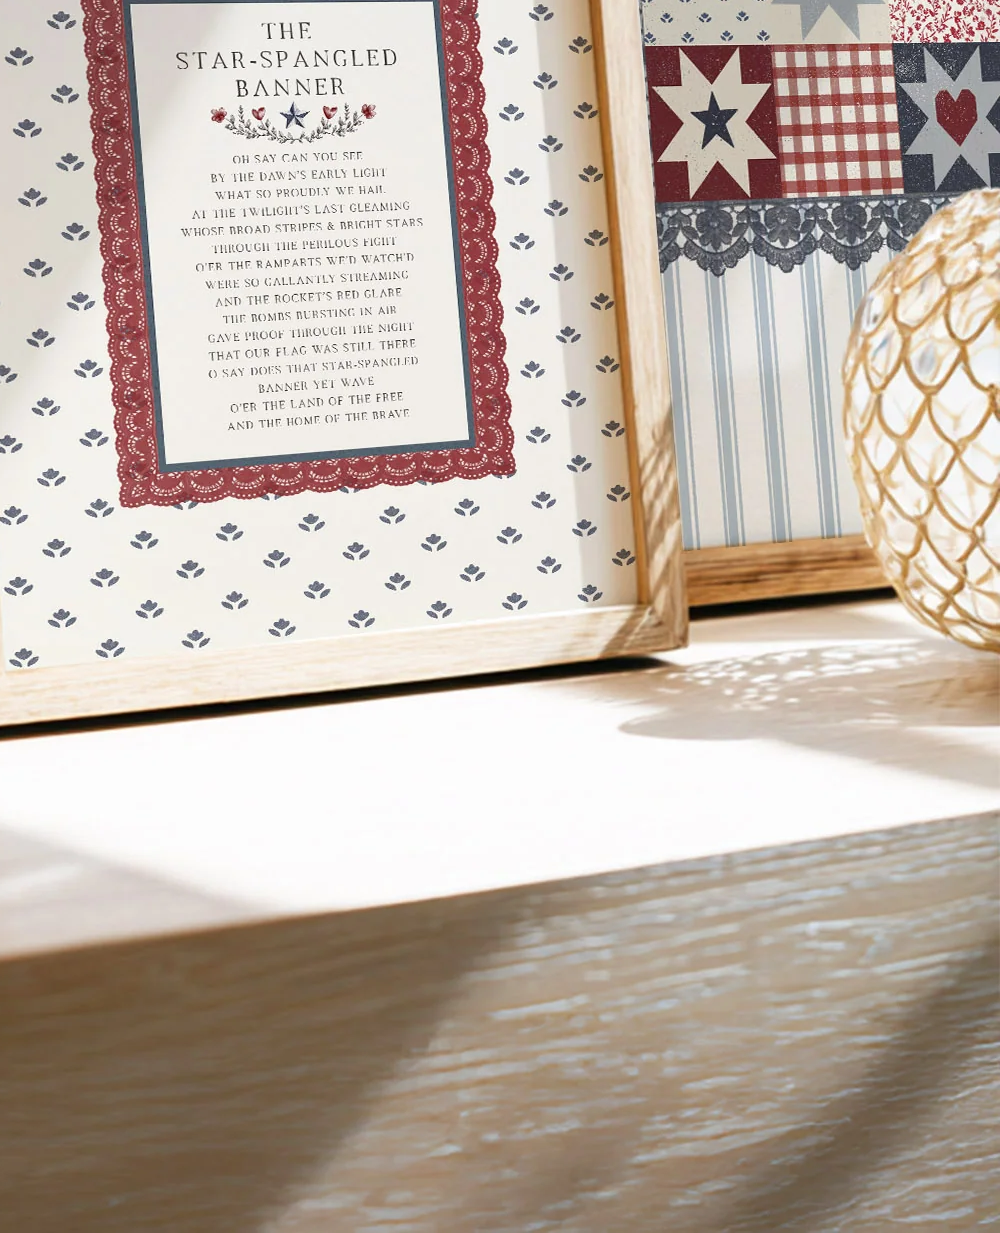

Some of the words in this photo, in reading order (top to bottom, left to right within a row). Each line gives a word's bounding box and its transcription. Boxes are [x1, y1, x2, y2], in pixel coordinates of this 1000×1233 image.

[261, 22, 311, 39] THE
[176, 49, 397, 70] STAR-SPANGLED
[236, 77, 345, 97] BANNER
[233, 155, 249, 164] OH
[254, 154, 276, 163] SAY
[282, 153, 307, 162] CAN
[313, 152, 337, 161] YOU
[343, 151, 362, 160] SEE
[211, 173, 225, 183] BY
[231, 172, 254, 182] THE
[260, 170, 306, 181] DAWN'S
[312, 169, 347, 179] EARLY
[353, 168, 387, 177] LIGHT
[215, 190, 251, 200] WHAT
[256, 190, 271, 198] SO
[276, 187, 330, 197] PROUDLY
[336, 186, 354, 195] WE
[359, 185, 386, 194] HAIL
[192, 210, 207, 219] AT
[213, 208, 235, 218] THE
[241, 205, 310, 217] TWILIGHT'S
[315, 204, 345, 214] LAST
[350, 201, 409, 212] GLEAMING
[181, 227, 224, 237] WHOSE
[229, 225, 270, 235] BROAD
[275, 222, 322, 232] STRIPES
[327, 222, 335, 230] &
[340, 220, 382, 230] BRIGHT
[386, 218, 423, 227] STARS
[212, 243, 269, 254] THROUGH
[275, 241, 297, 251] THE
[303, 238, 358, 249] PERILOUS
[364, 237, 397, 246] FIGHT
[196, 262, 222, 272] O'ER
[228, 261, 251, 270] THE
[256, 257, 321, 268] RAMPARTS
[326, 256, 356, 265] WE'D
[361, 253, 414, 263] WATCH'D
[205, 280, 239, 289] WERE
[244, 278, 259, 287] SO
[265, 275, 335, 286] GALLANTLY
[340, 271, 408, 282] STREAMING
[216, 297, 241, 307] AND
[246, 295, 270, 305] THE
[274, 292, 332, 304] ROCKET'S
[337, 290, 359, 300] RED
[364, 288, 401, 298] GLARE
[223, 314, 246, 324] THE
[251, 312, 291, 322] BOMBS
[296, 308, 355, 319] BURSTING
[360, 307, 372, 316] IN
[378, 306, 396, 315] AIR
[208, 333, 240, 343] GAVE
[245, 330, 284, 341] PROOF
[289, 326, 346, 338] THROUGH
[351, 324, 373, 334] THE
[379, 322, 414, 332] NIGHT
[208, 350, 240, 361] THAT
[245, 348, 269, 358] OUR
[276, 346, 306, 357] FLAG
[312, 344, 338, 354] WAS
[343, 342, 374, 352] STILL
[379, 339, 416, 350] THERE
[208, 370, 217, 378] O
[222, 368, 244, 377] SAY
[251, 366, 281, 376] DOES
[286, 363, 317, 373] THAT
[322, 357, 418, 370] STAR-SPANGLED
[259, 381, 307, 393] BANNER
[313, 380, 335, 389] YET
[341, 376, 374, 386] WAVE
[230, 402, 256, 413] O'ER
[262, 400, 285, 411] THE
[290, 398, 323, 408] LAND
[328, 396, 343, 406] OF
[348, 394, 370, 404] THE
[376, 392, 403, 402] FREE
[228, 421, 253, 430] AND
[258, 419, 281, 428] THE
[287, 416, 320, 426] HOME
[325, 414, 340, 423] OF
[345, 412, 367, 421] THE
[372, 409, 409, 419] BRAVE
